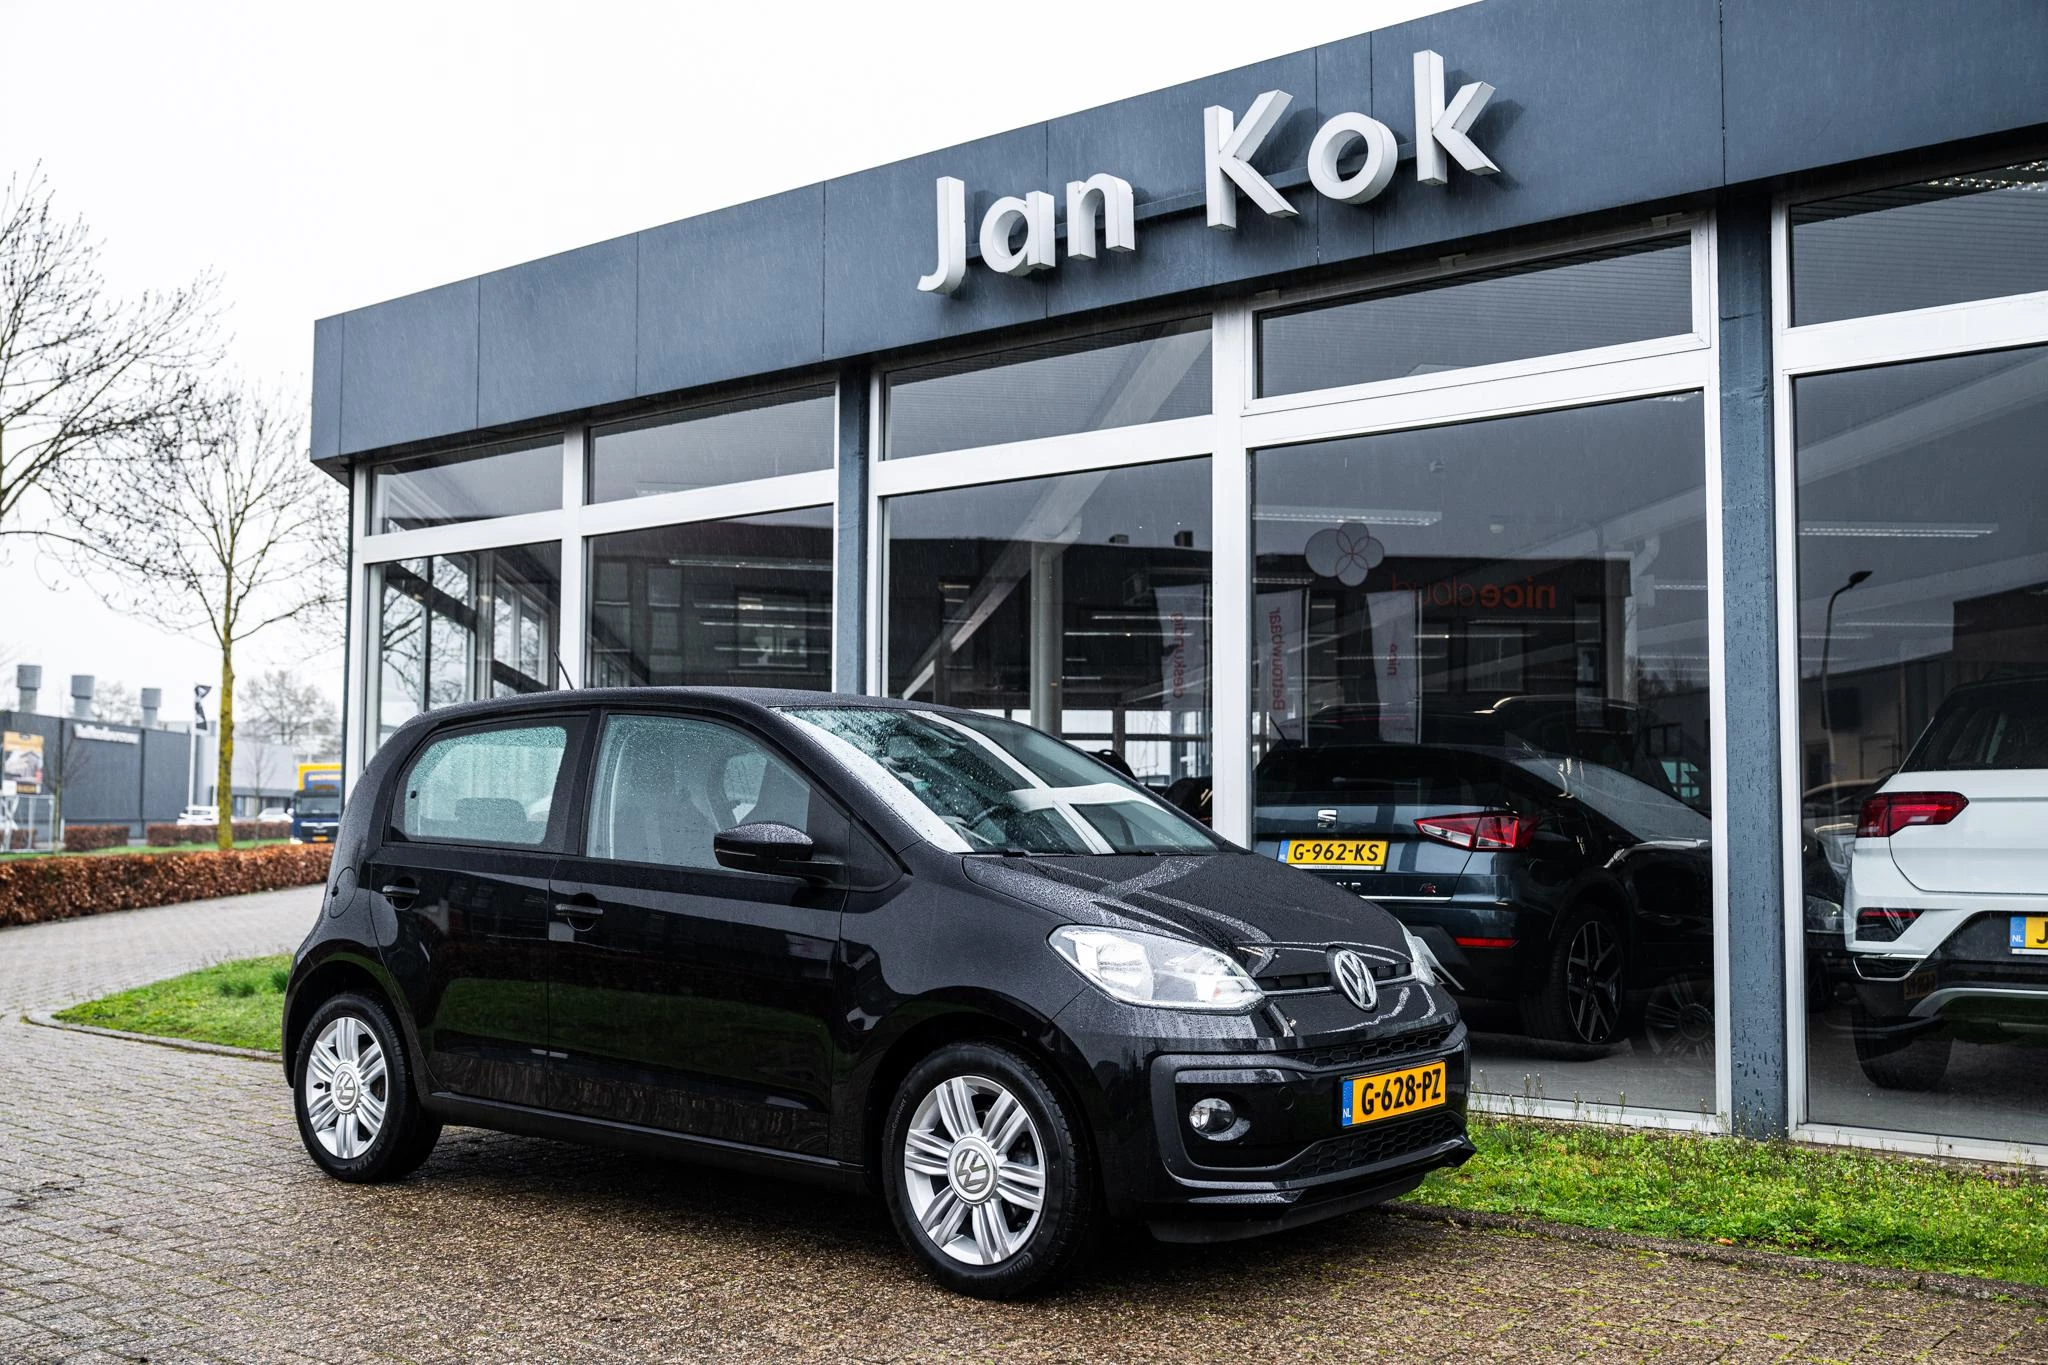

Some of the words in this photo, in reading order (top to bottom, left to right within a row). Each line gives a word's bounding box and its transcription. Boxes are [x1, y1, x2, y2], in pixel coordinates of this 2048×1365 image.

[917, 172, 1136, 295] Jan
[1203, 49, 1501, 232] Kok
[1293, 843, 1380, 862] G-962-KS
[2012, 934, 2024, 943] NL
[1343, 1107, 1352, 1119] NL
[1361, 1068, 1442, 1116] G-628-PZ
